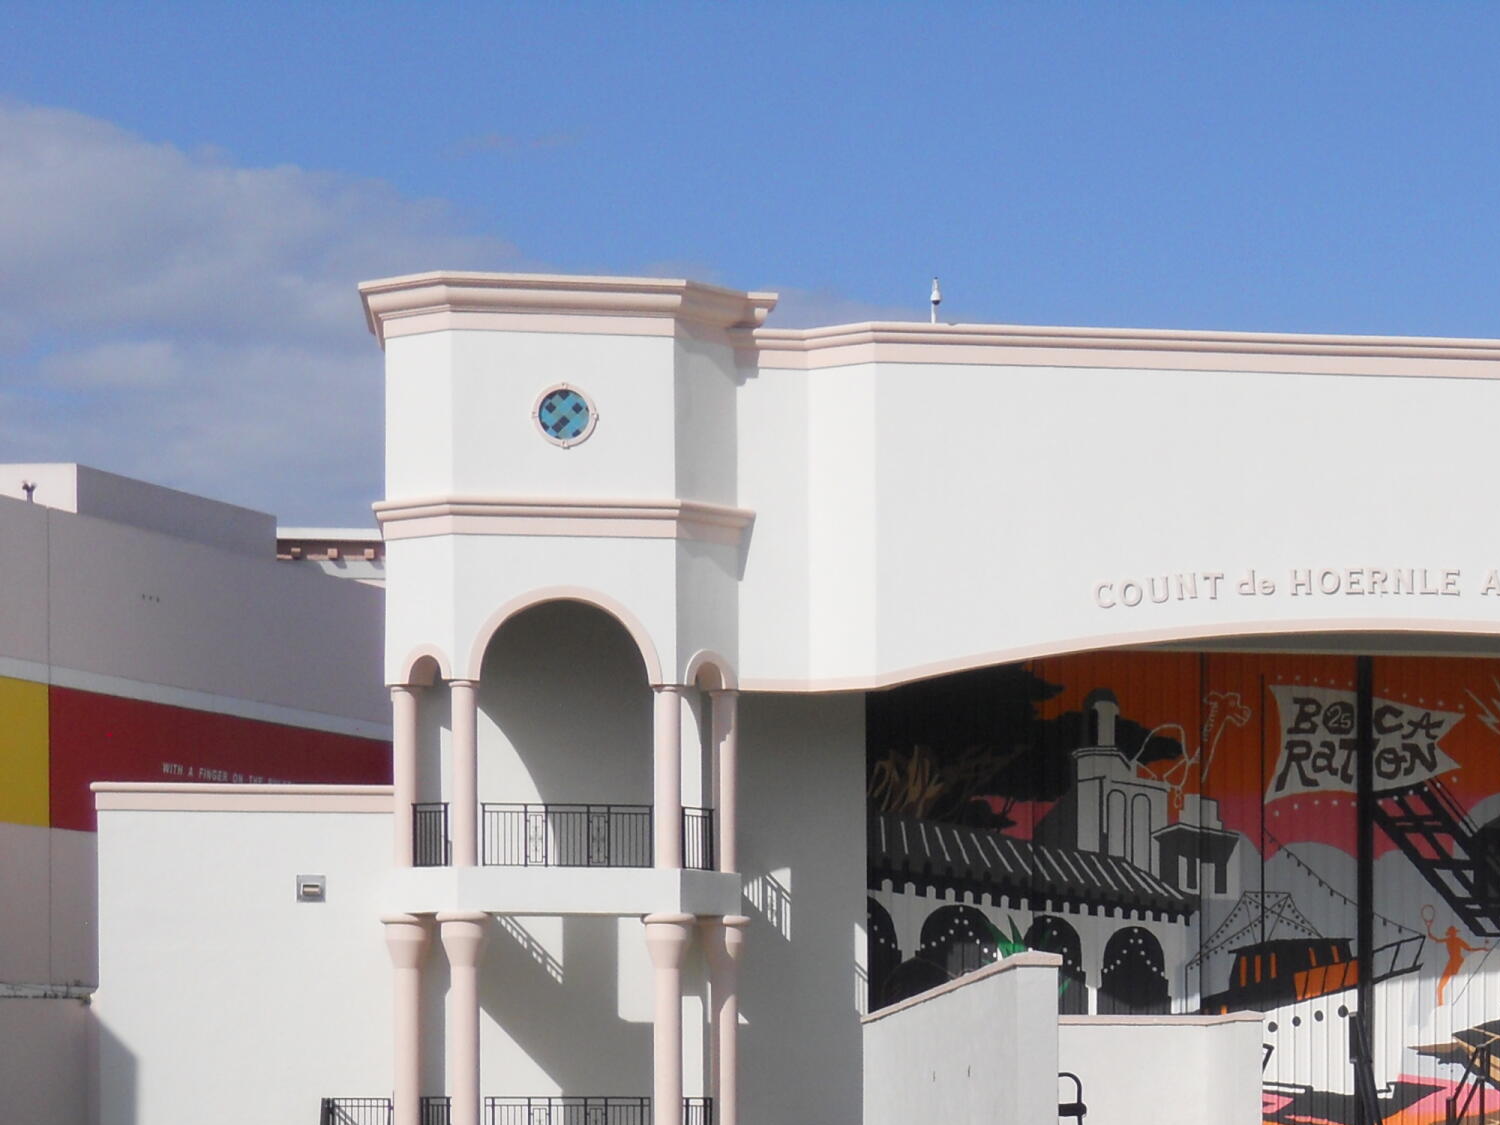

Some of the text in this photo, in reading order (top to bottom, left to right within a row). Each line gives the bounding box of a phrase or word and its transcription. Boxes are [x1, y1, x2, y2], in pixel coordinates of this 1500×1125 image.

[1094, 572, 1224, 609] COUNT
[1236, 569, 1276, 596] de
[1289, 568, 1461, 597] HOERNLE
[162, 762, 184, 776] WITH
[187, 766, 193, 777] A
[199, 768, 229, 782] FINGER
